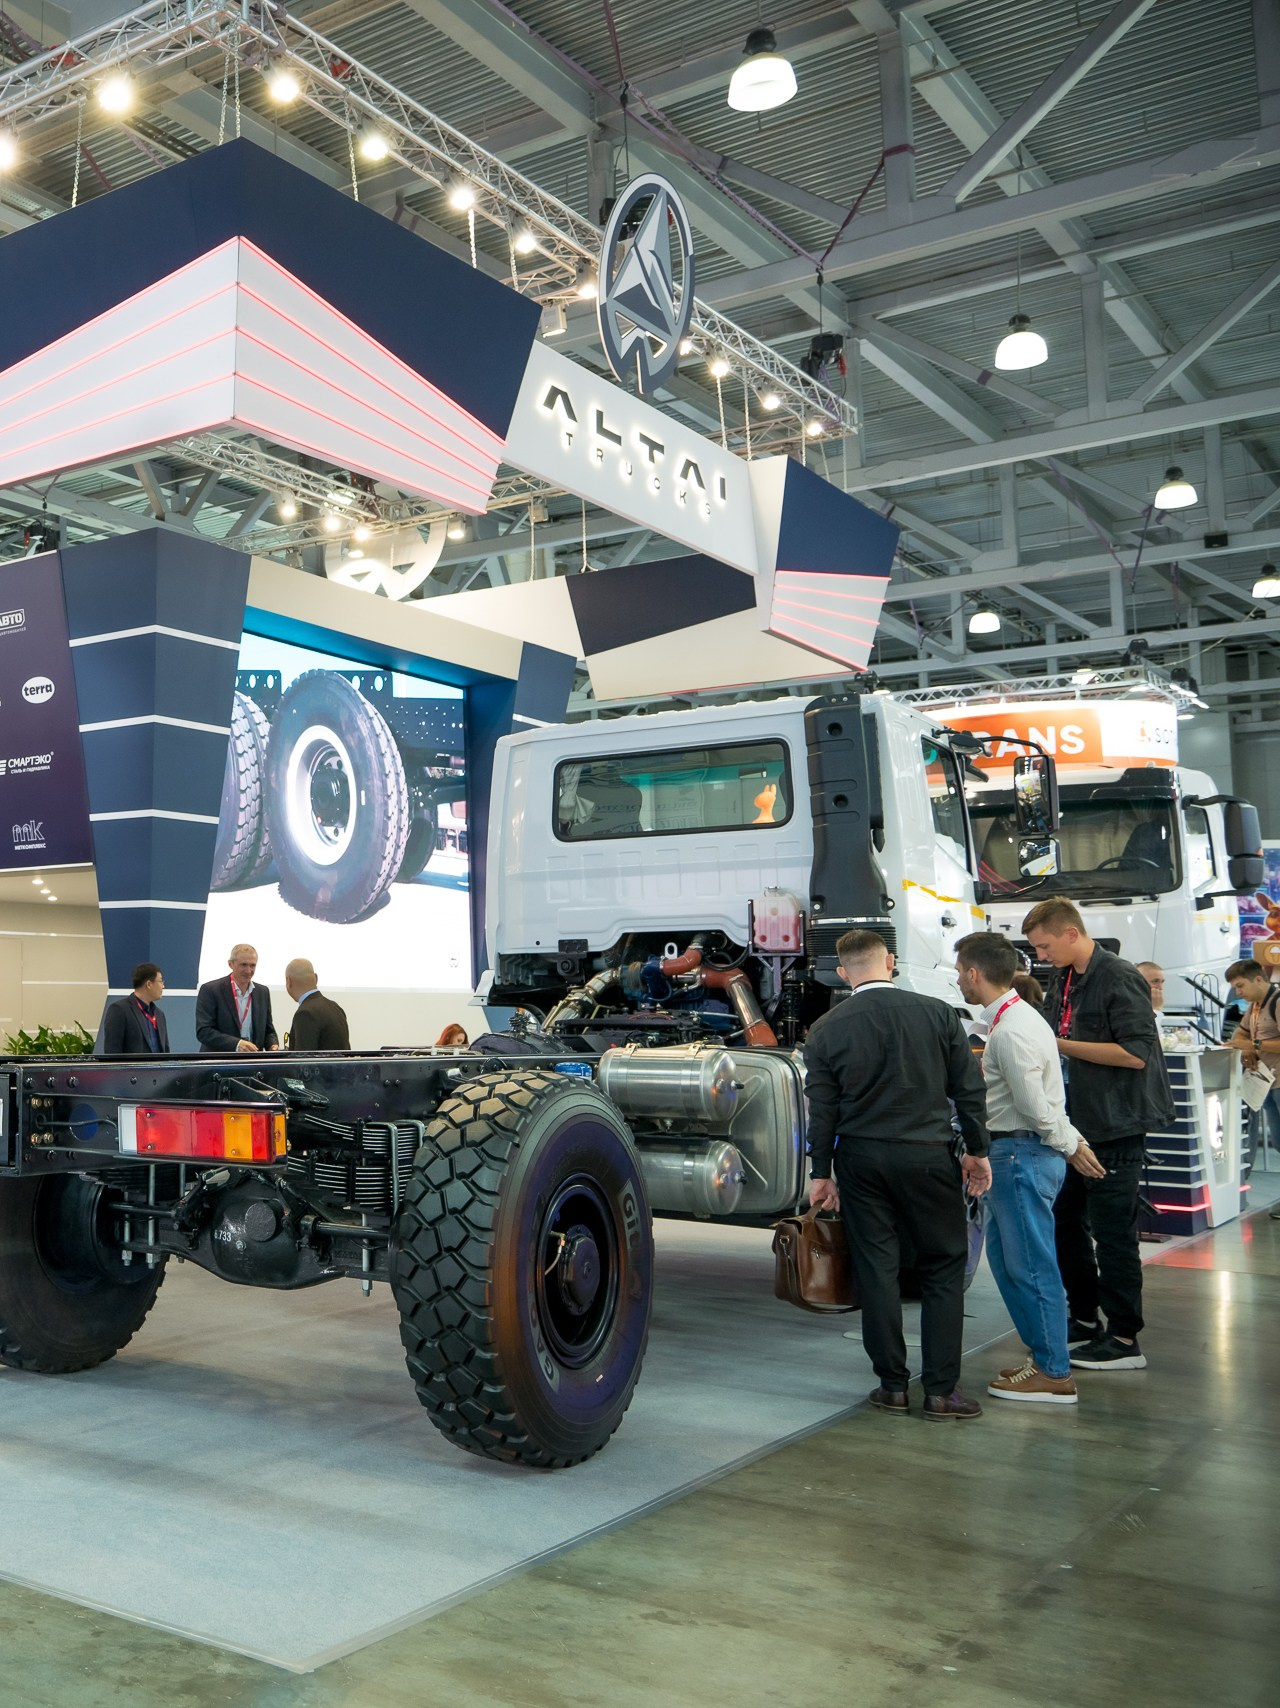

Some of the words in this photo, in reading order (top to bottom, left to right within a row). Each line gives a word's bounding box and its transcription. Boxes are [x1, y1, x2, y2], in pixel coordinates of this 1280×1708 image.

[543, 385, 726, 501] ALTAI
[565, 432, 712, 515] TRUCKS
[23, 684, 53, 697] terra
[8, 753, 52, 768] СМАРТЭКО
